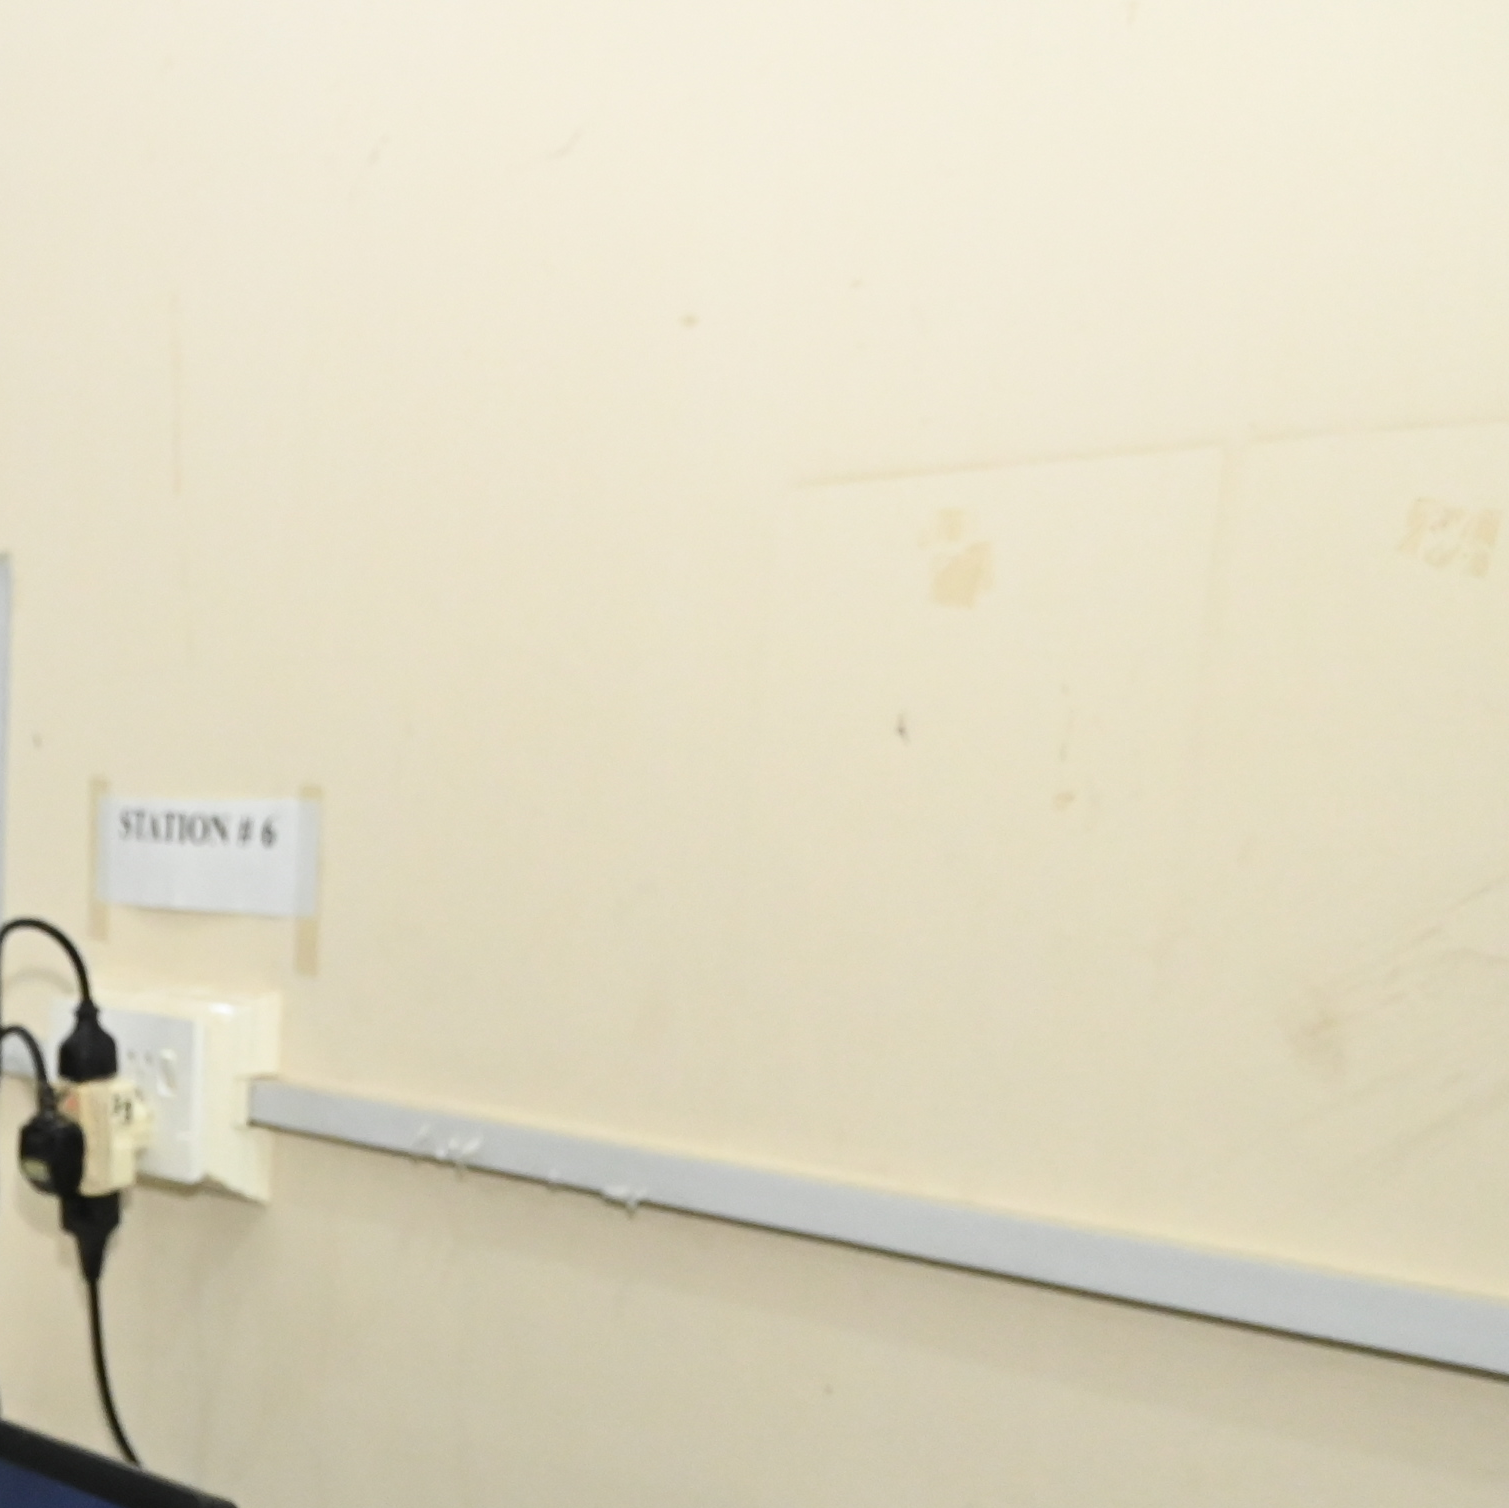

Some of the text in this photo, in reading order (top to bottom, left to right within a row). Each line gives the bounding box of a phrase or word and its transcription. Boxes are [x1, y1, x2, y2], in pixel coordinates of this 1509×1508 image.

[118, 808, 279, 849] STATION # 6
